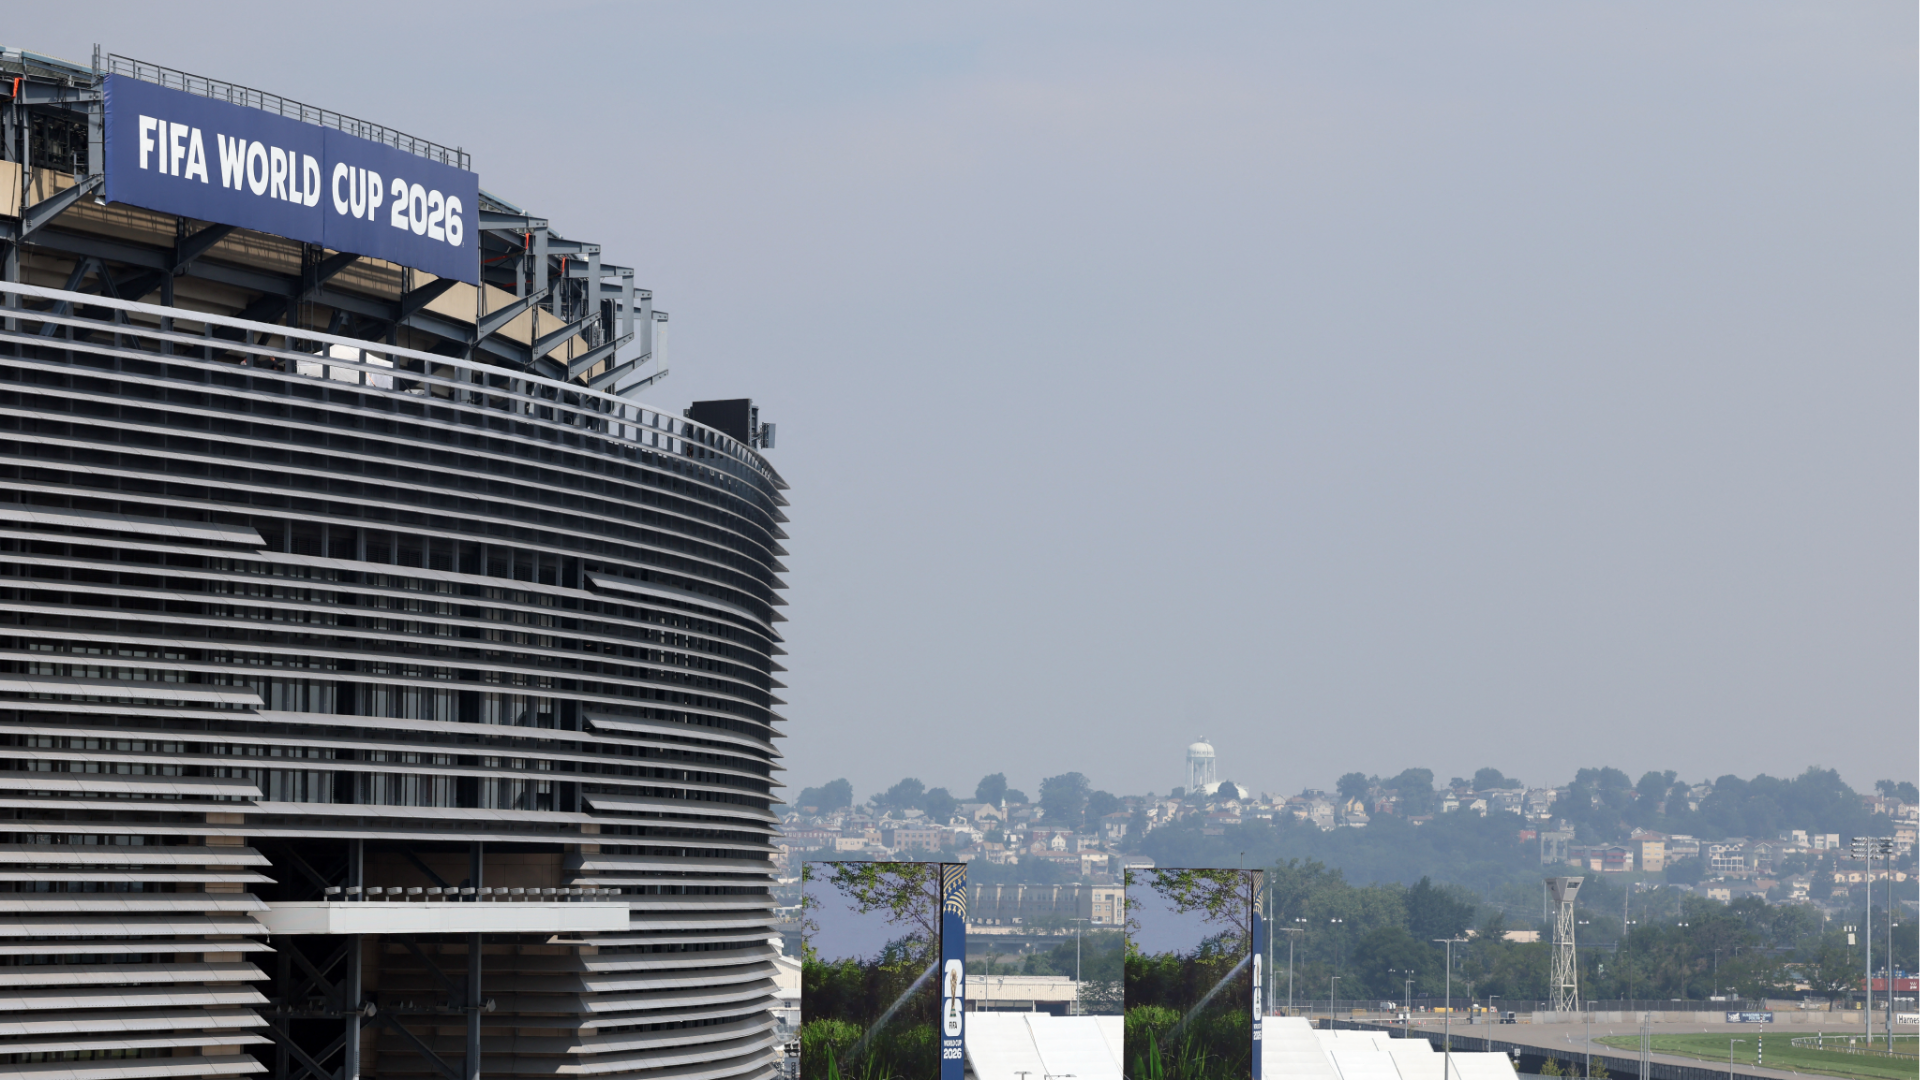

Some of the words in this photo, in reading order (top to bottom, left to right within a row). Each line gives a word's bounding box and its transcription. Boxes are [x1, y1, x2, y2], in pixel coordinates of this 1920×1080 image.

[139, 114, 208, 184] FIFA
[217, 133, 321, 207] WORLD
[332, 162, 383, 221] CUP
[391, 178, 464, 247] 2026
[949, 1021, 957, 1029] FIFA
[943, 1048, 962, 1059] 2026
